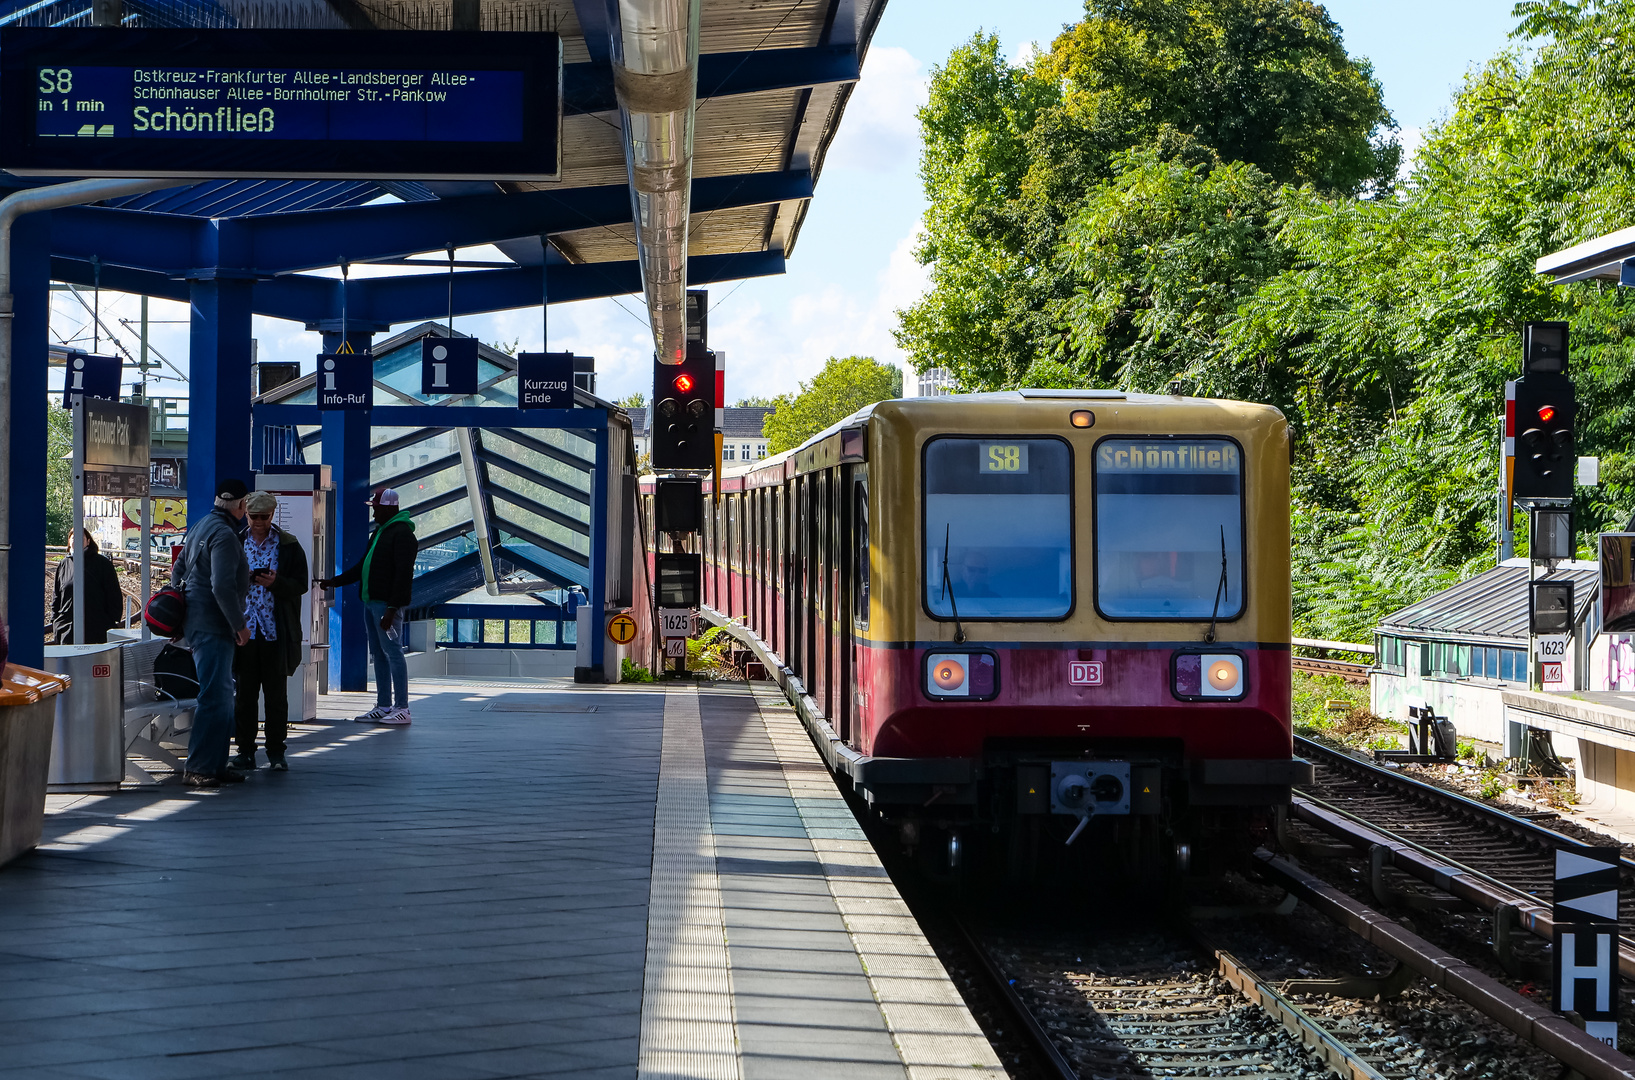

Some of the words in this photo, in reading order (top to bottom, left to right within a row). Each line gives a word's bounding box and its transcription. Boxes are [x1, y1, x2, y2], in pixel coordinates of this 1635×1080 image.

[39, 69, 72, 94] S8
[133, 86, 221, 101] Schönhauser
[39, 98, 52, 112] in
[61, 99, 69, 112] 1
[76, 98, 105, 112] min
[133, 106, 275, 133] Schönfließ
[524, 379, 567, 393] Kurzzug
[323, 393, 366, 405] Info-Ruf
[524, 393, 551, 403] Ende
[88, 411, 116, 450] Treptower
[116, 415, 130, 446] Park
[988, 445, 1020, 472] S8
[1099, 444, 1238, 471] Schönfließ
[664, 615, 688, 629] 1625
[1540, 641, 1564, 655] 1623
[94, 666, 110, 676] DB
[1071, 664, 1101, 683] DB
[1560, 932, 1611, 1013] H
